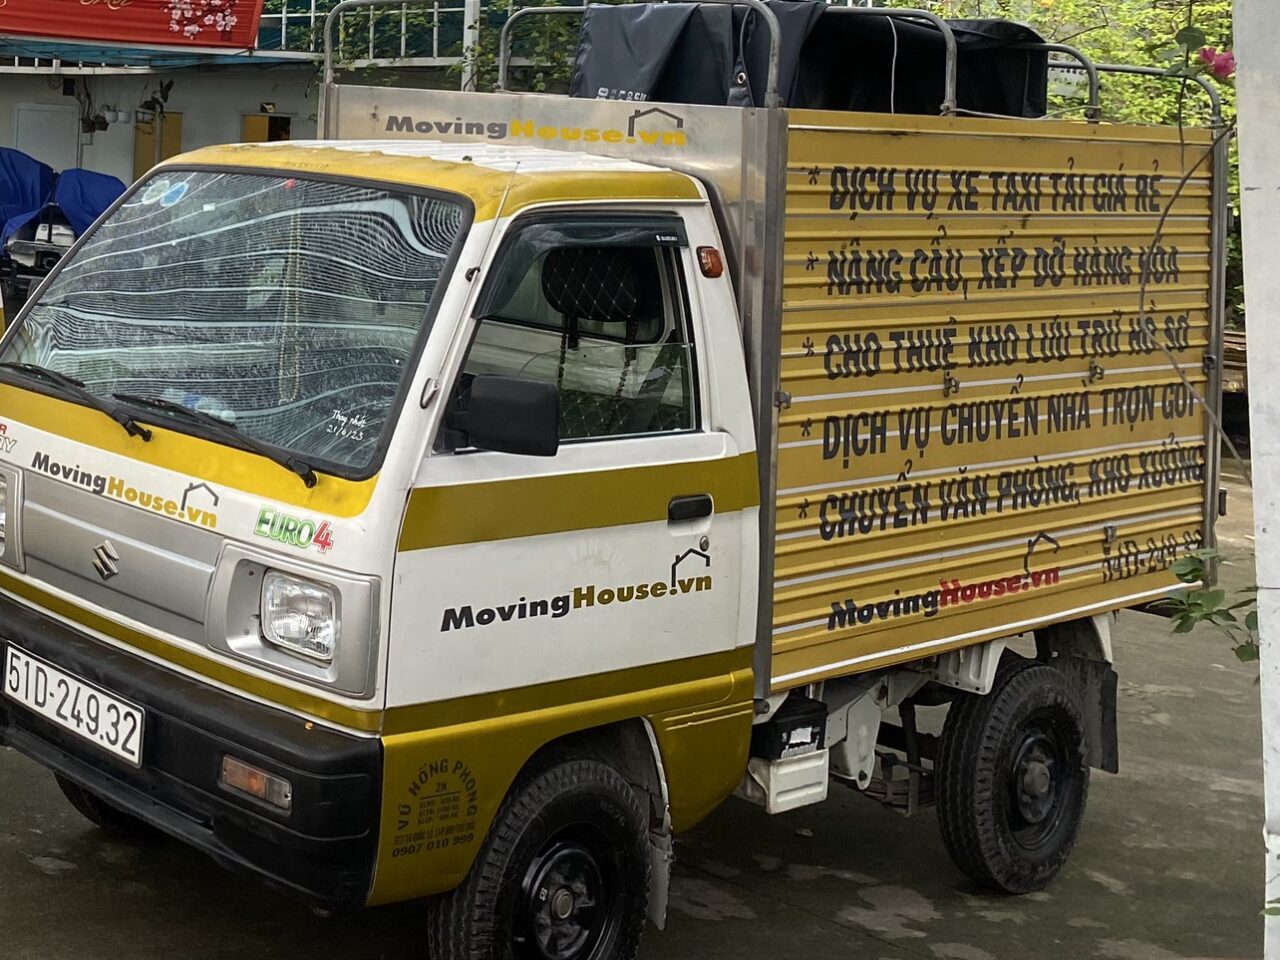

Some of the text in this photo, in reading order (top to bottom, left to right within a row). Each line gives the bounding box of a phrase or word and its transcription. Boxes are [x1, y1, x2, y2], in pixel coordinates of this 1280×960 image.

[829, 156, 1162, 221] DỊCH VỤ XE TAXI TẢI GIÁ RẺ
[826, 237, 903, 296] NÂNG
[978, 230, 1027, 289] XẾP
[1073, 235, 1132, 287] HÀNG
[823, 333, 883, 380] CHO
[889, 316, 958, 372] THUÊ
[967, 322, 1019, 368] KHO
[822, 408, 890, 468] DỊCH
[898, 406, 933, 458] VỤ
[940, 373, 1039, 446] CHUYỂN
[1100, 384, 1155, 432] TRỌN
[31, 450, 217, 528] MovingHouse.vn
[819, 459, 932, 540] CHUYỂN
[939, 467, 987, 520] VĂN
[1088, 453, 1130, 498] KHO
[440, 574, 713, 632] MovingHouse.vn
[8, 653, 138, 757] 51D-249.32
[435, 781, 447, 792] 2N
[452, 760, 478, 817] PHONG
[392, 843, 423, 858] 0907
[426, 838, 449, 850] 010
[452, 833, 474, 845] 999
